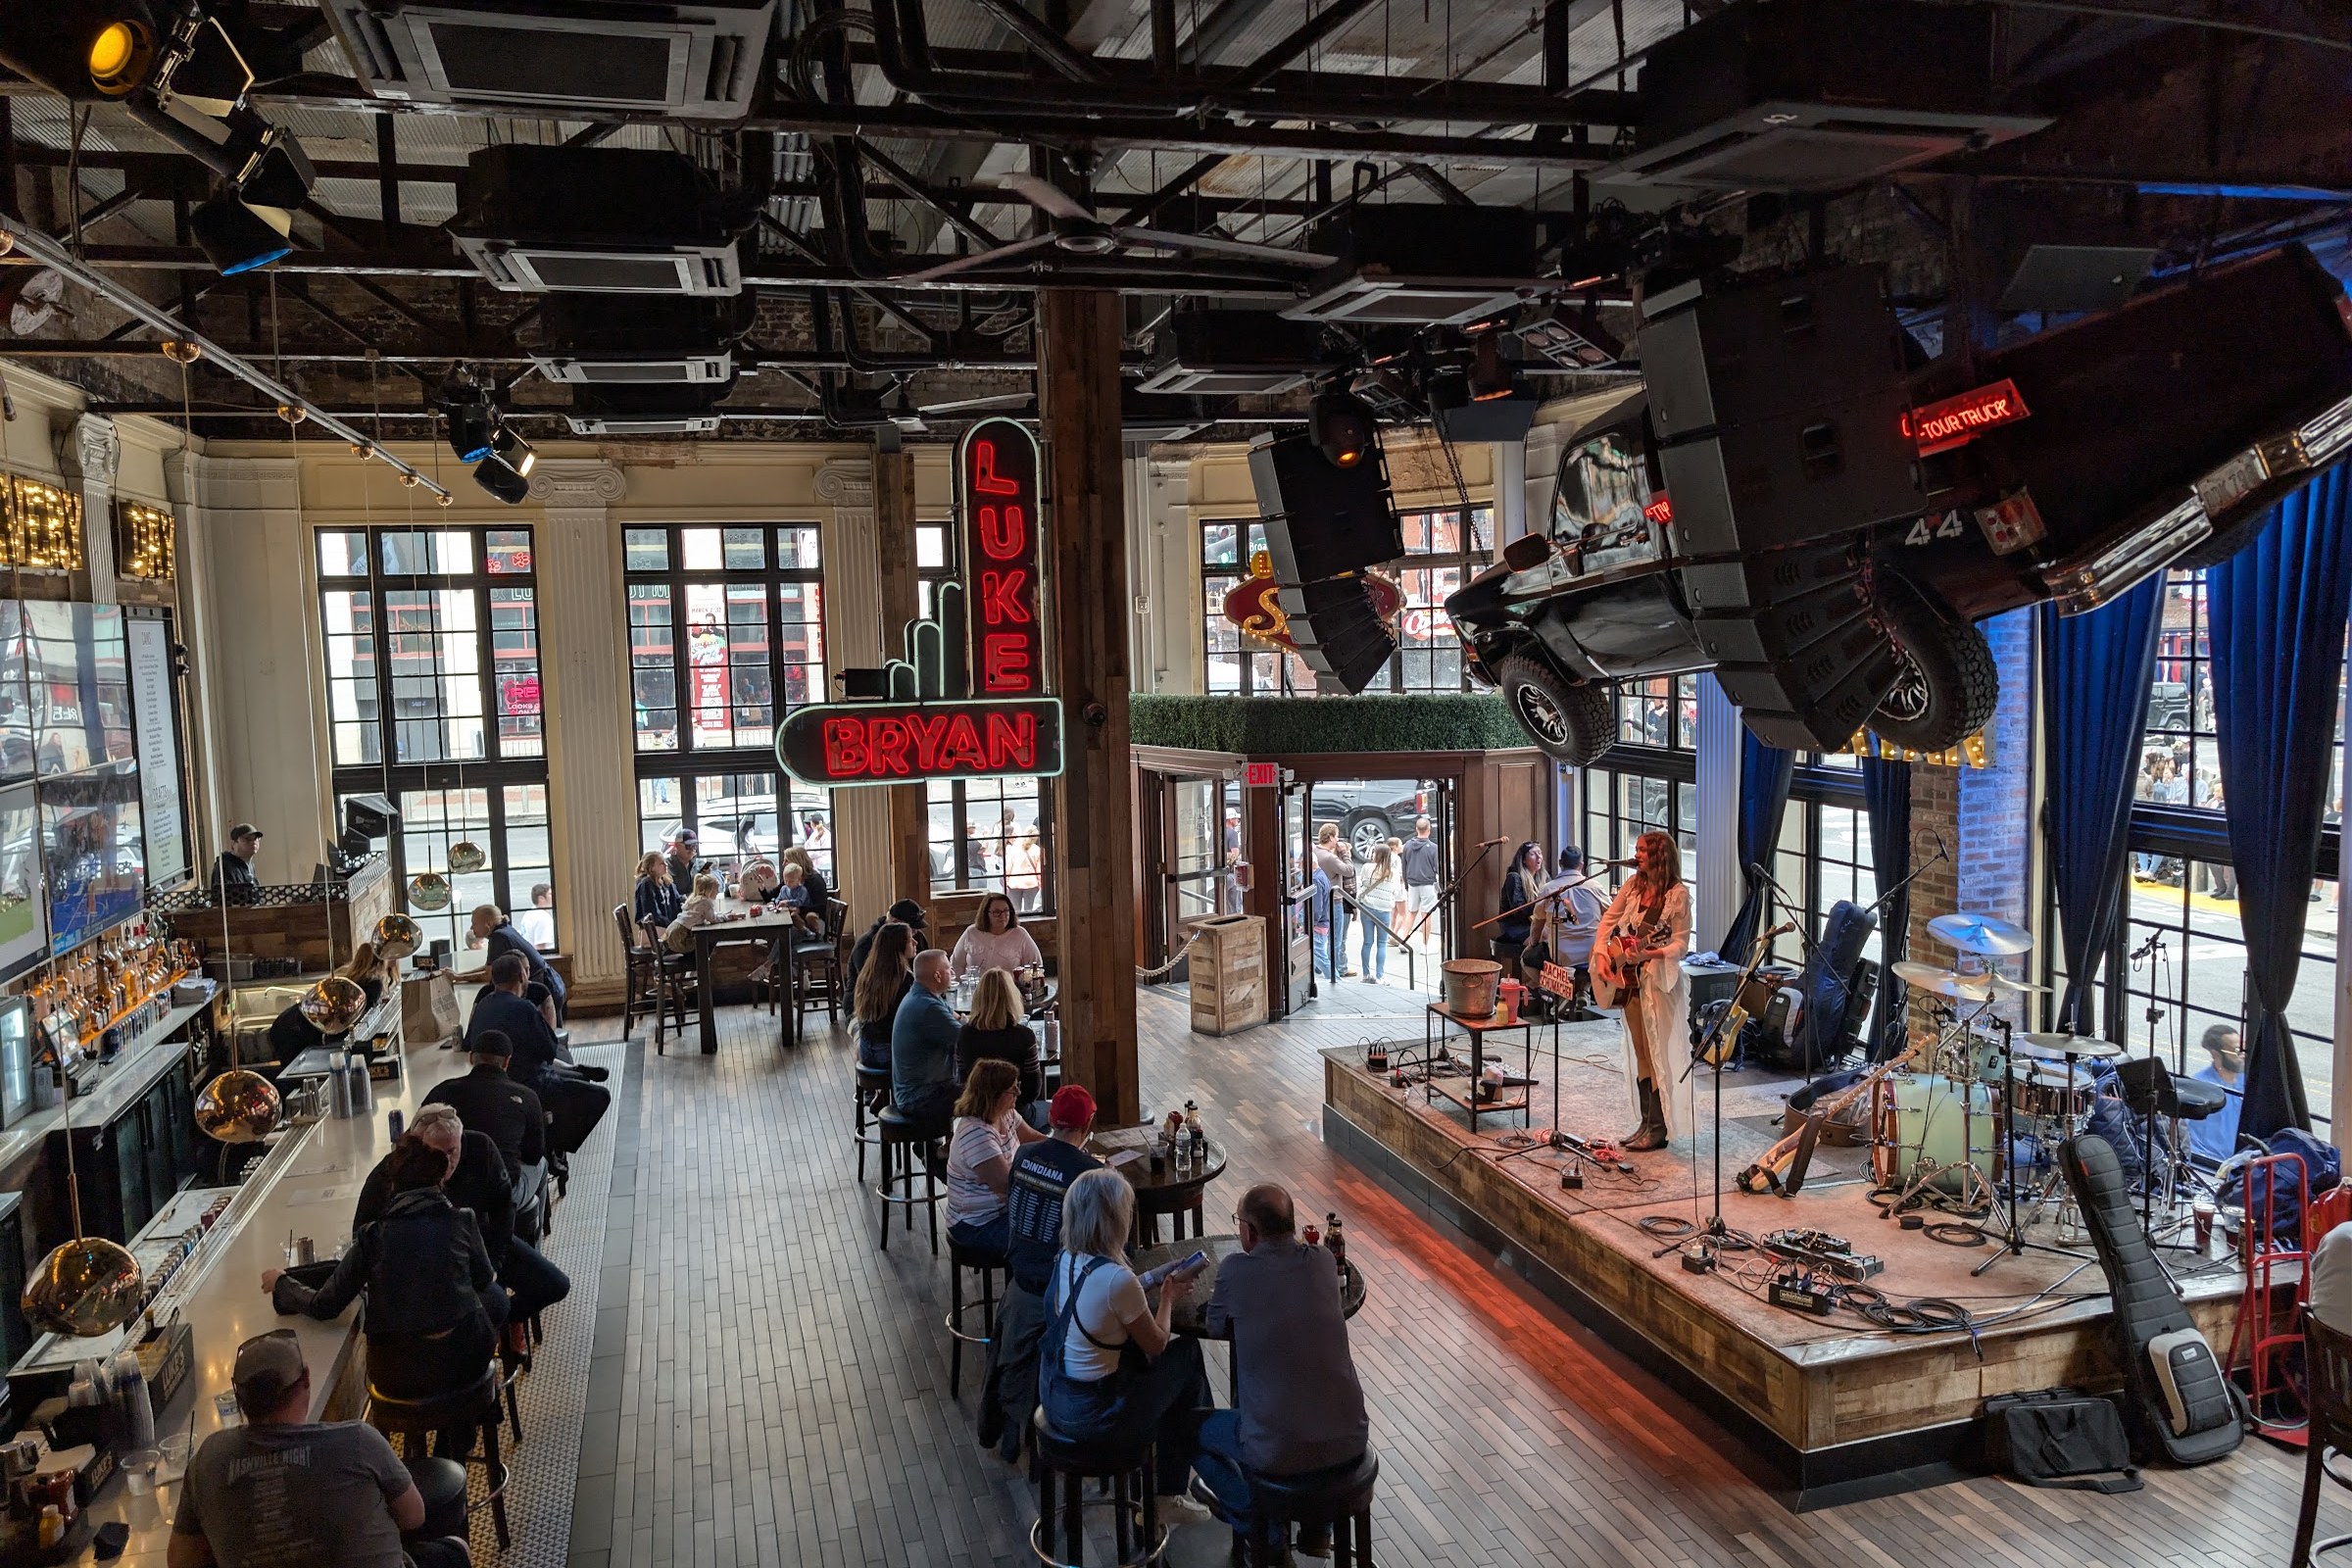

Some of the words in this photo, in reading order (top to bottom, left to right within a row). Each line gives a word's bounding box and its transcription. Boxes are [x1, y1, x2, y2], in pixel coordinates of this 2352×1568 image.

[1958, 399, 2011, 425] TRUCK
[976, 441, 1030, 691] LUKE
[823, 714, 1035, 775] BRYAN
[1248, 763, 1274, 784] EXIT
[1544, 962, 1570, 984] RACHEL
[282, 1446, 312, 1468] NIGHT
